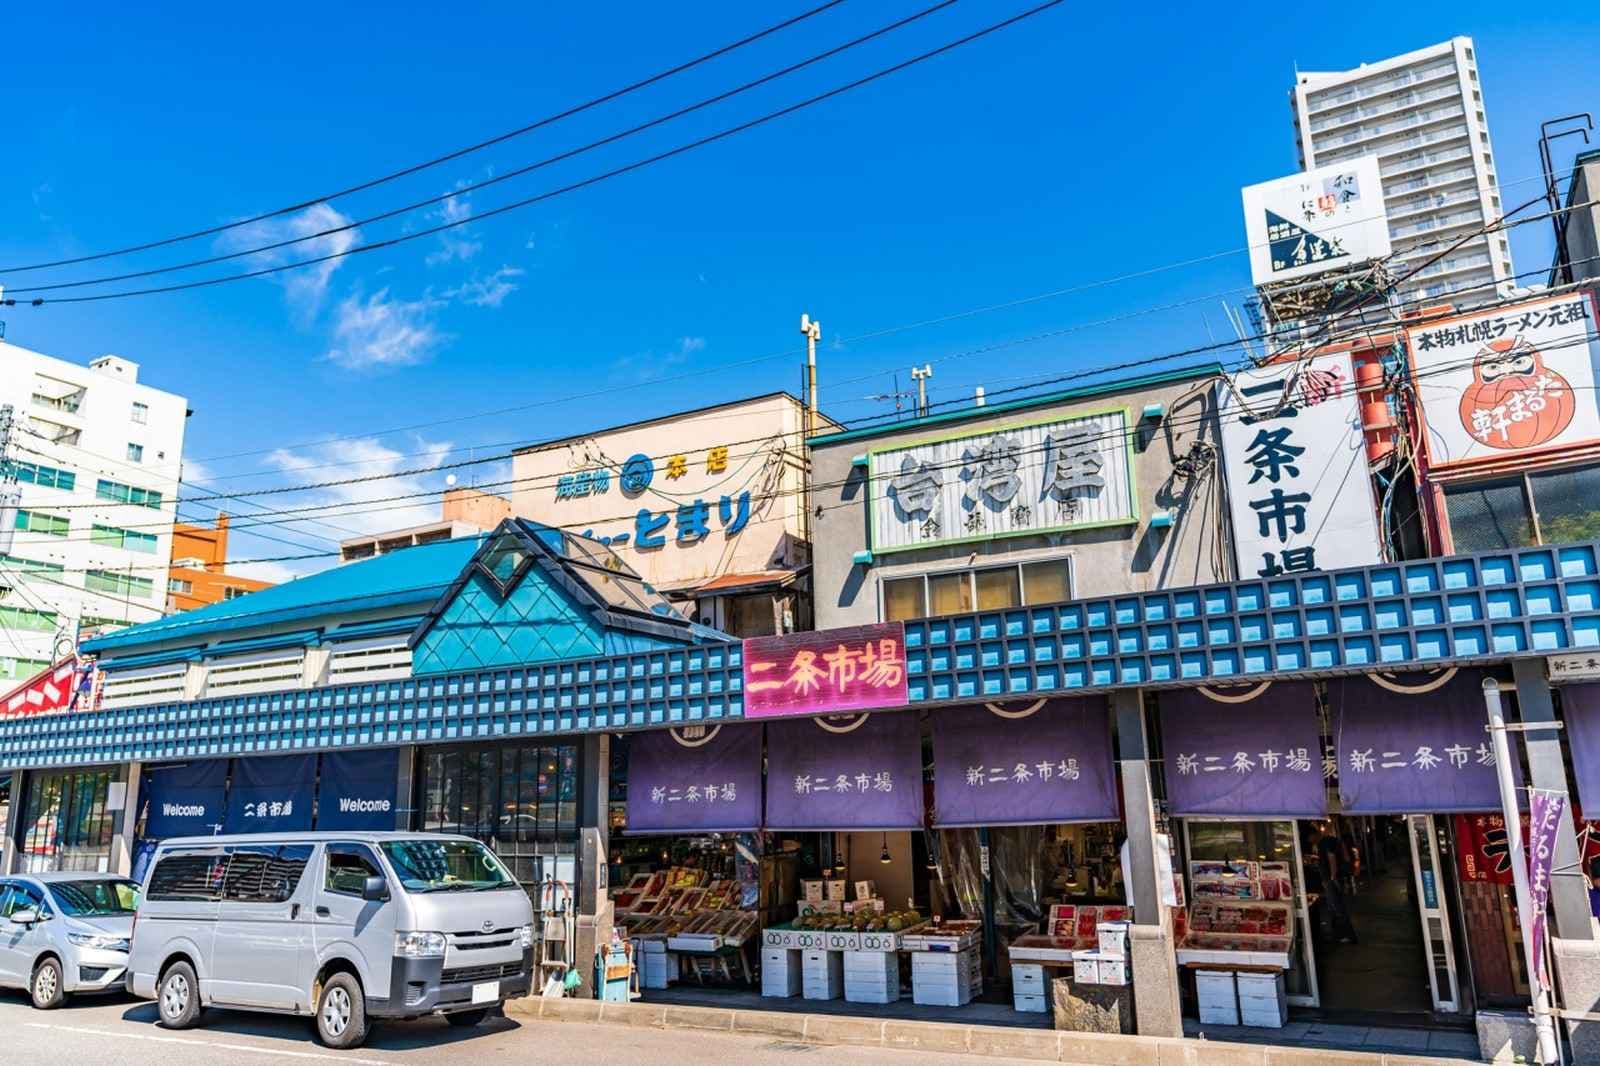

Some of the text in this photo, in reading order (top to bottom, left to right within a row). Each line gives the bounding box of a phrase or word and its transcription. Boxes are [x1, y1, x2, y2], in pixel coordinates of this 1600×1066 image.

[1417, 301, 1591, 352] 本物札幌ラーメン元祖
[746, 639, 904, 695] 二条市場
[966, 758, 1080, 786] 新二条市場
[1176, 748, 1311, 776] 新二条市場
[651, 782, 737, 804] 新二条市場
[794, 772, 893, 793] 新二条市場
[162, 803, 205, 817] Welcome
[339, 797, 391, 813] Welcome
